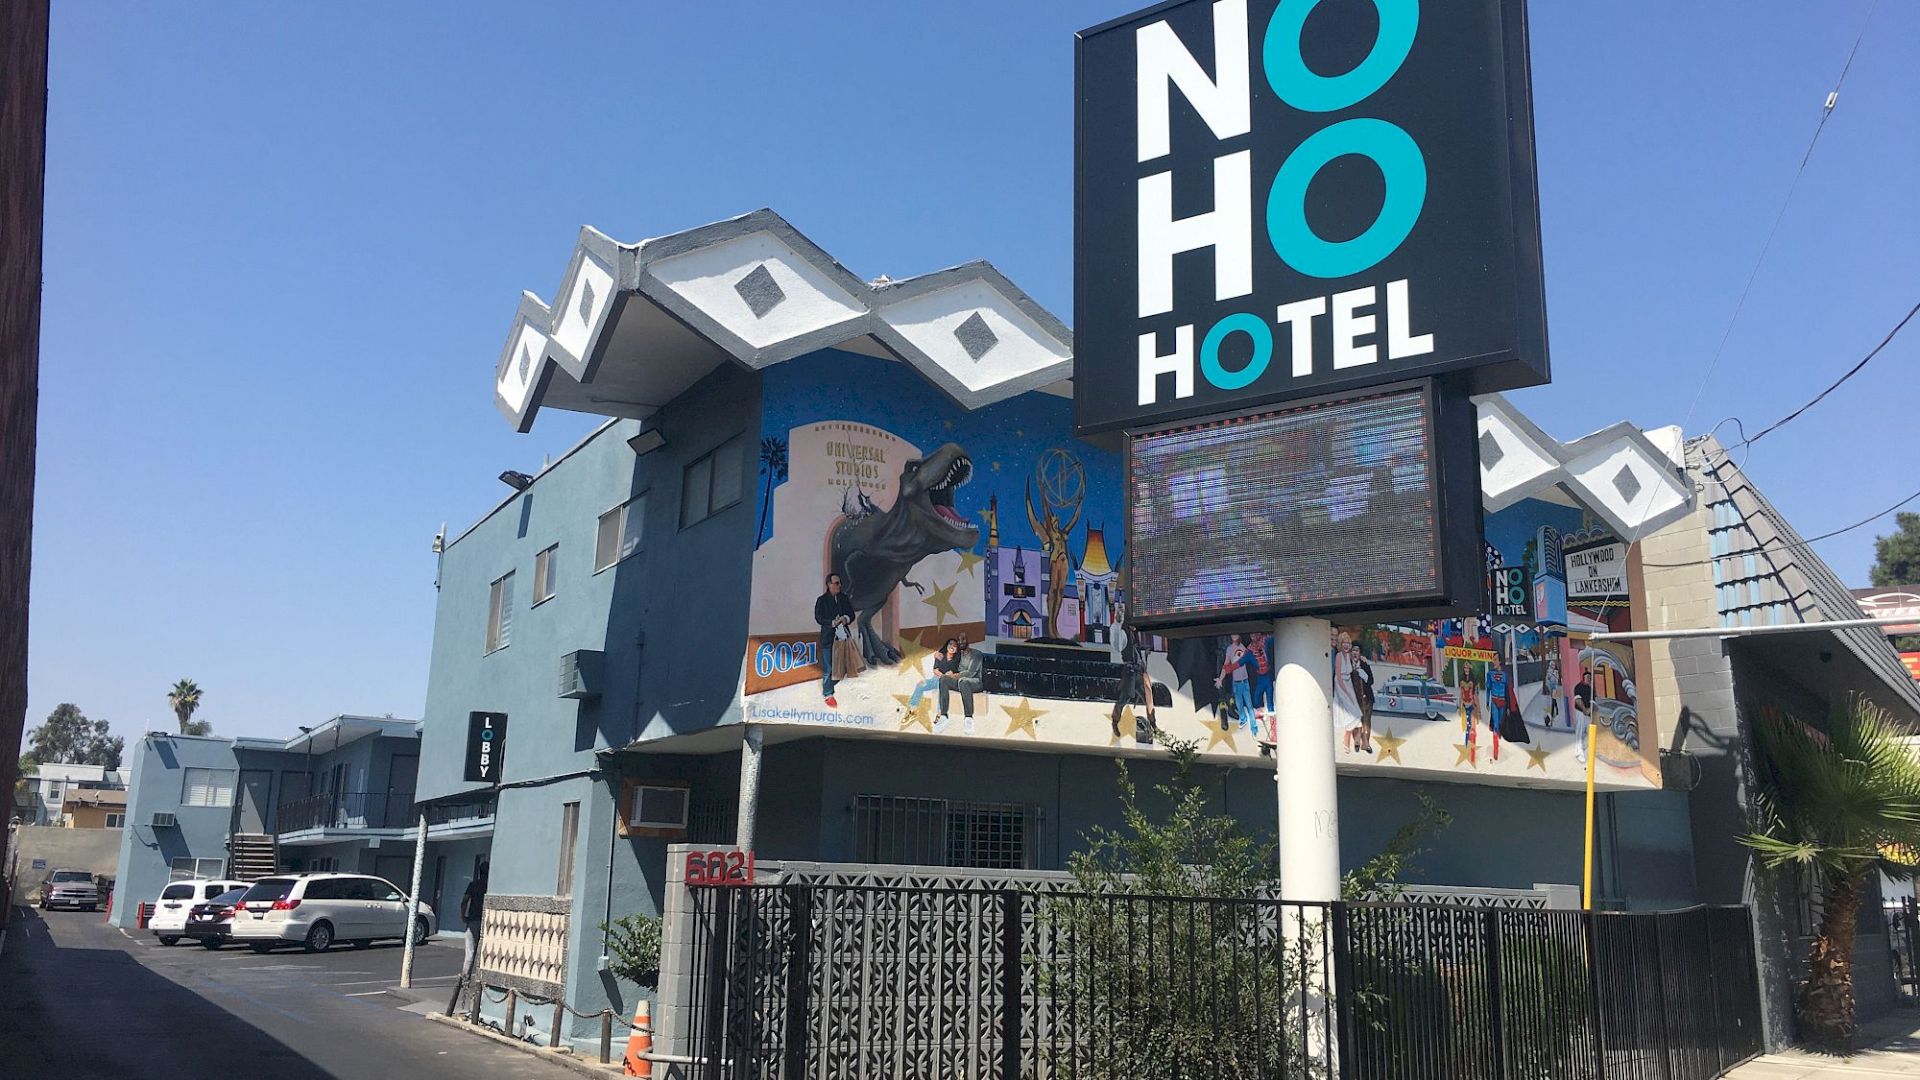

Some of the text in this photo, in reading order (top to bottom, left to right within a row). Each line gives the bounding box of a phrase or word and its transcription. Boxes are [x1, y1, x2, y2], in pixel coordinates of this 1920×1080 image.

[1136, 0, 1420, 163] NO
[1138, 118, 1427, 319] HO
[1138, 279, 1435, 406] HOTEL
[826, 441, 886, 463] UNIVERSAL
[836, 461, 879, 478] STUDIOS
[1571, 548, 1615, 568] HOLLYWOOD
[1496, 568, 1523, 587] NO
[1588, 566, 1598, 578] ON
[1496, 586, 1525, 605] HO
[1575, 579, 1622, 593] LANKERSHIM
[1497, 605, 1527, 615] HOTEL
[755, 641, 818, 678] 6021
[1445, 648, 1497, 660] LIQUOR WIN
[480, 717, 493, 778] LOBBY
[685, 850, 755, 885] 6021
